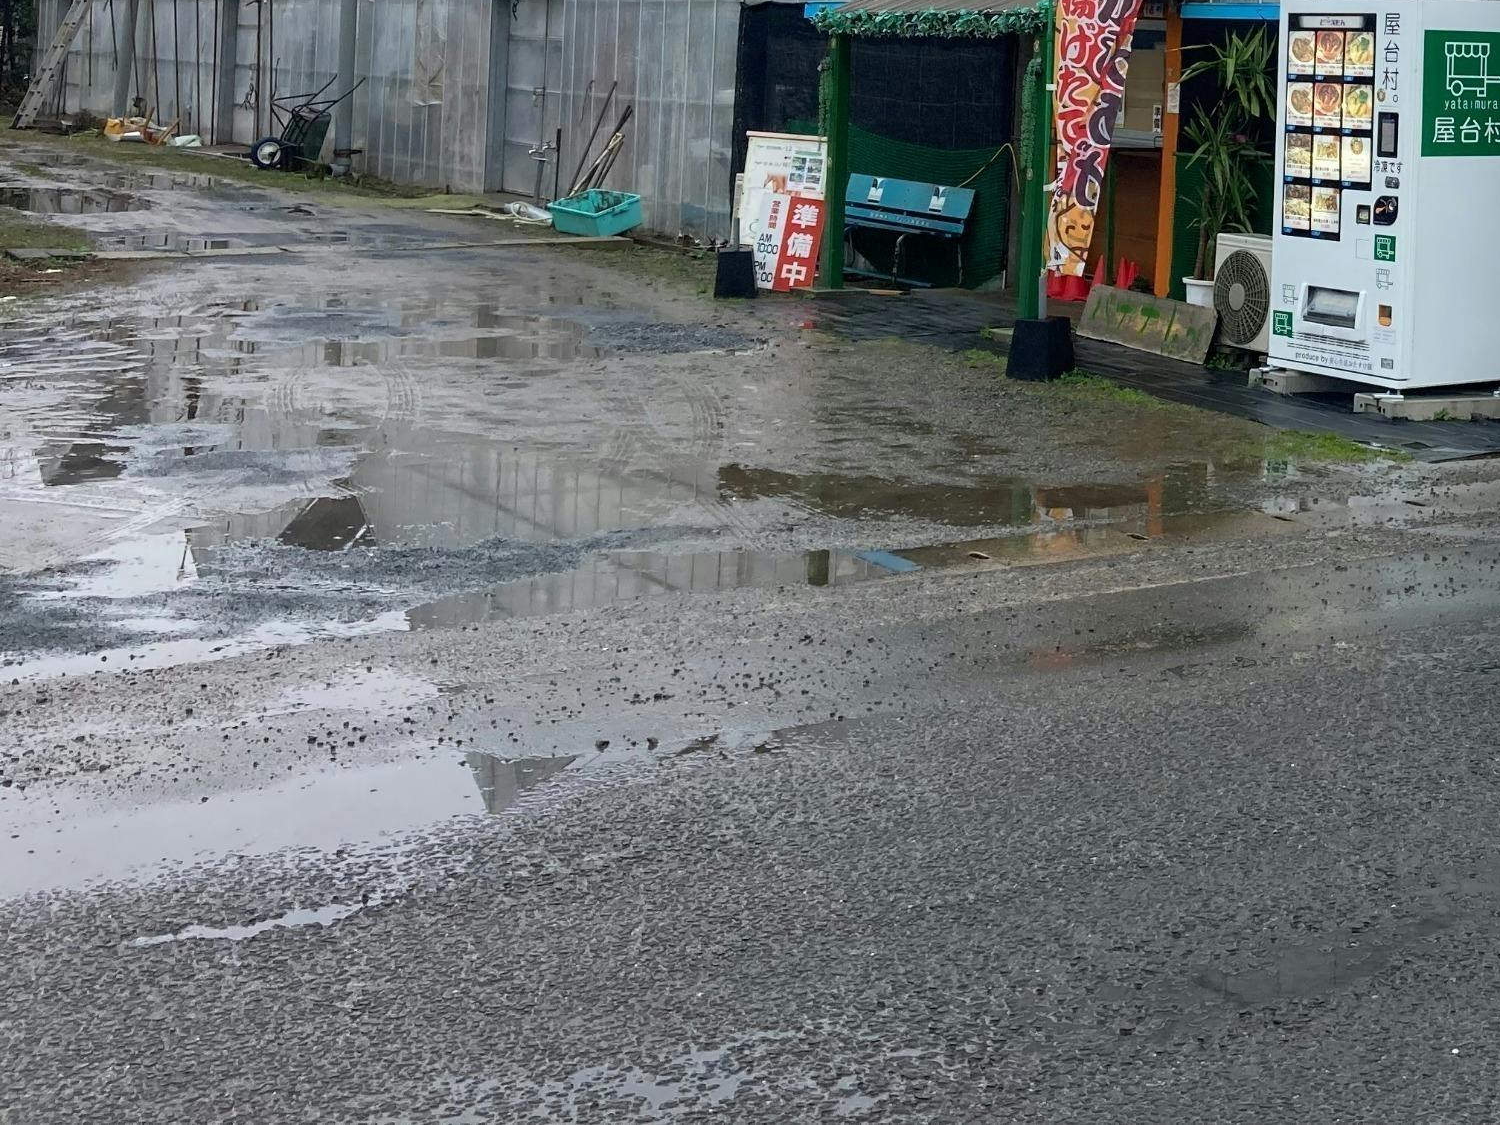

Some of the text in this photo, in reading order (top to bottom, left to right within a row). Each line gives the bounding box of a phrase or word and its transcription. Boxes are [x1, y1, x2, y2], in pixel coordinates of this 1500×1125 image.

[1444, 97, 1498, 110] yataimura
[759, 233, 772, 244] AM
[780, 204, 819, 286] 準備中
